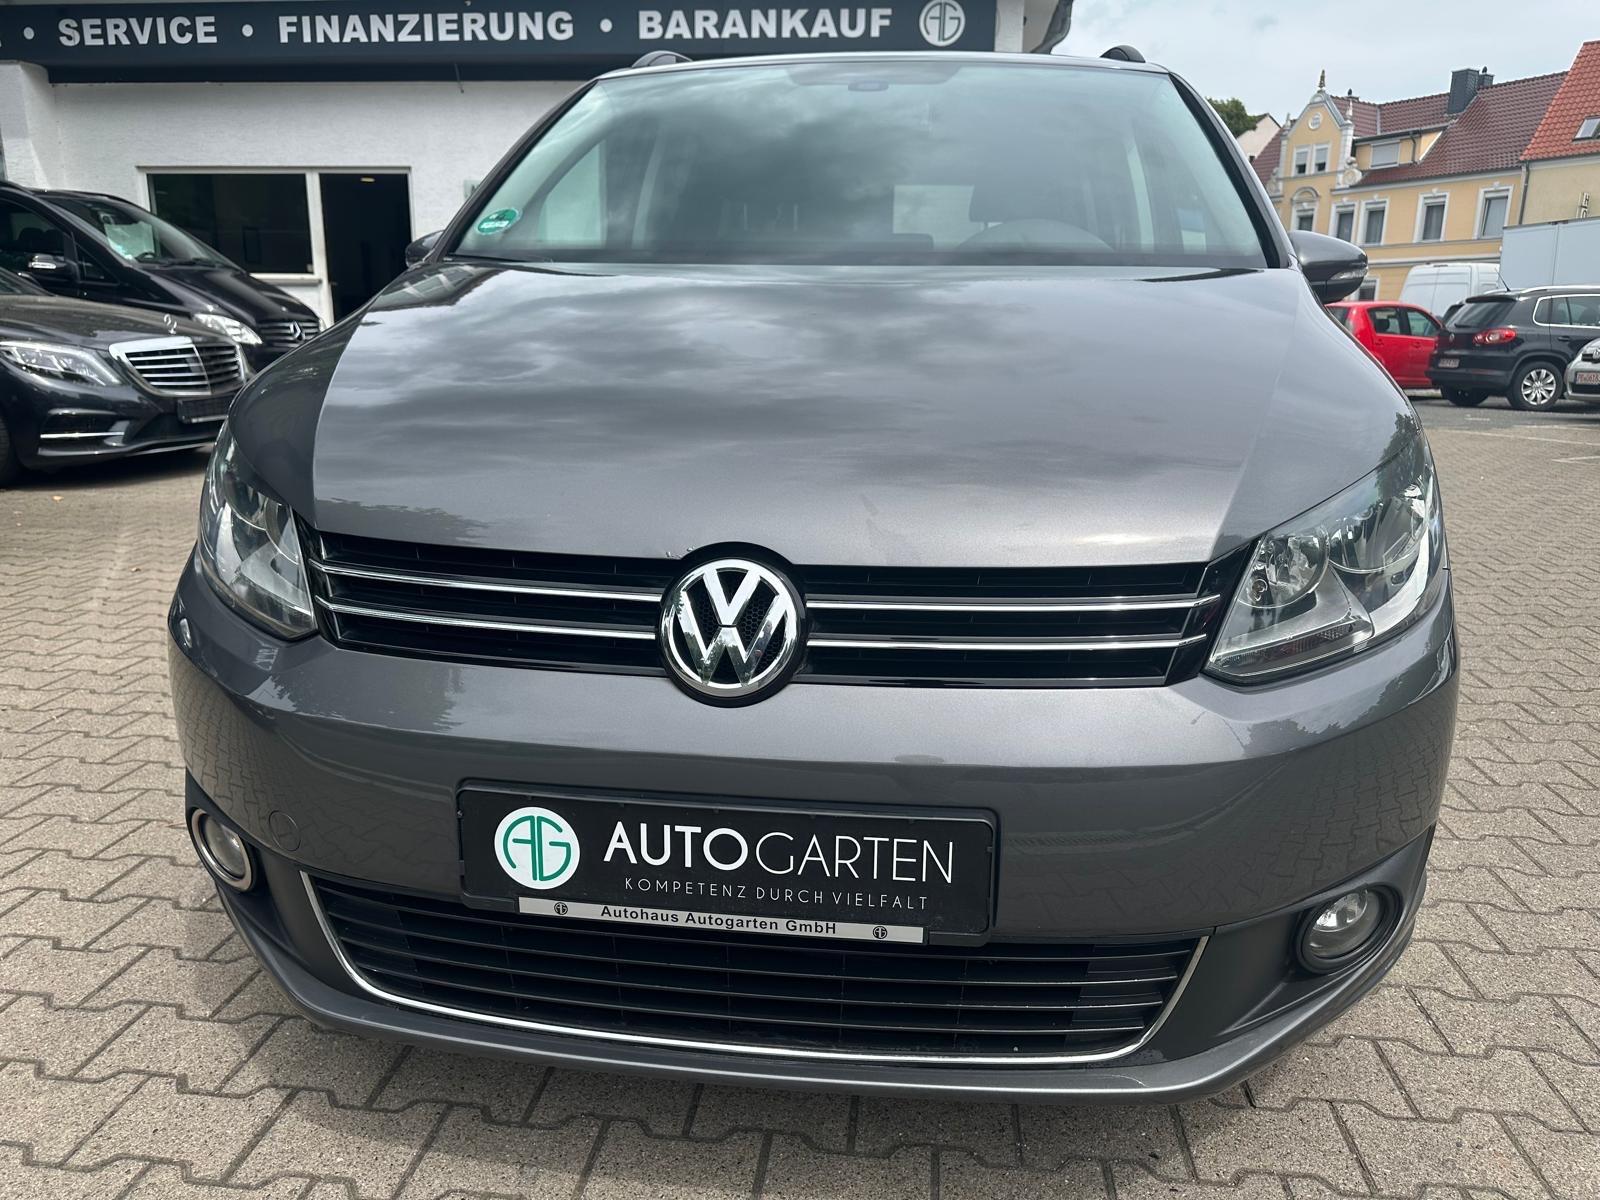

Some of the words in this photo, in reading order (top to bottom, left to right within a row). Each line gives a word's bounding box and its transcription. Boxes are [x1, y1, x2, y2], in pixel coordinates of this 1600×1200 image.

[58, 16, 218, 47] SERVICE
[279, 11, 574, 44] FINANZIERUNG
[638, 8, 893, 40] BARANKAUF
[603, 821, 954, 884] AUTOGARTEN
[625, 877, 746, 899] KOMPETENZ
[756, 886, 823, 904] DURCH
[832, 891, 928, 910] VIELFALT
[600, 905, 679, 923] Autohaus
[685, 912, 779, 930] Autogarten
[785, 920, 837, 935] GmbH
